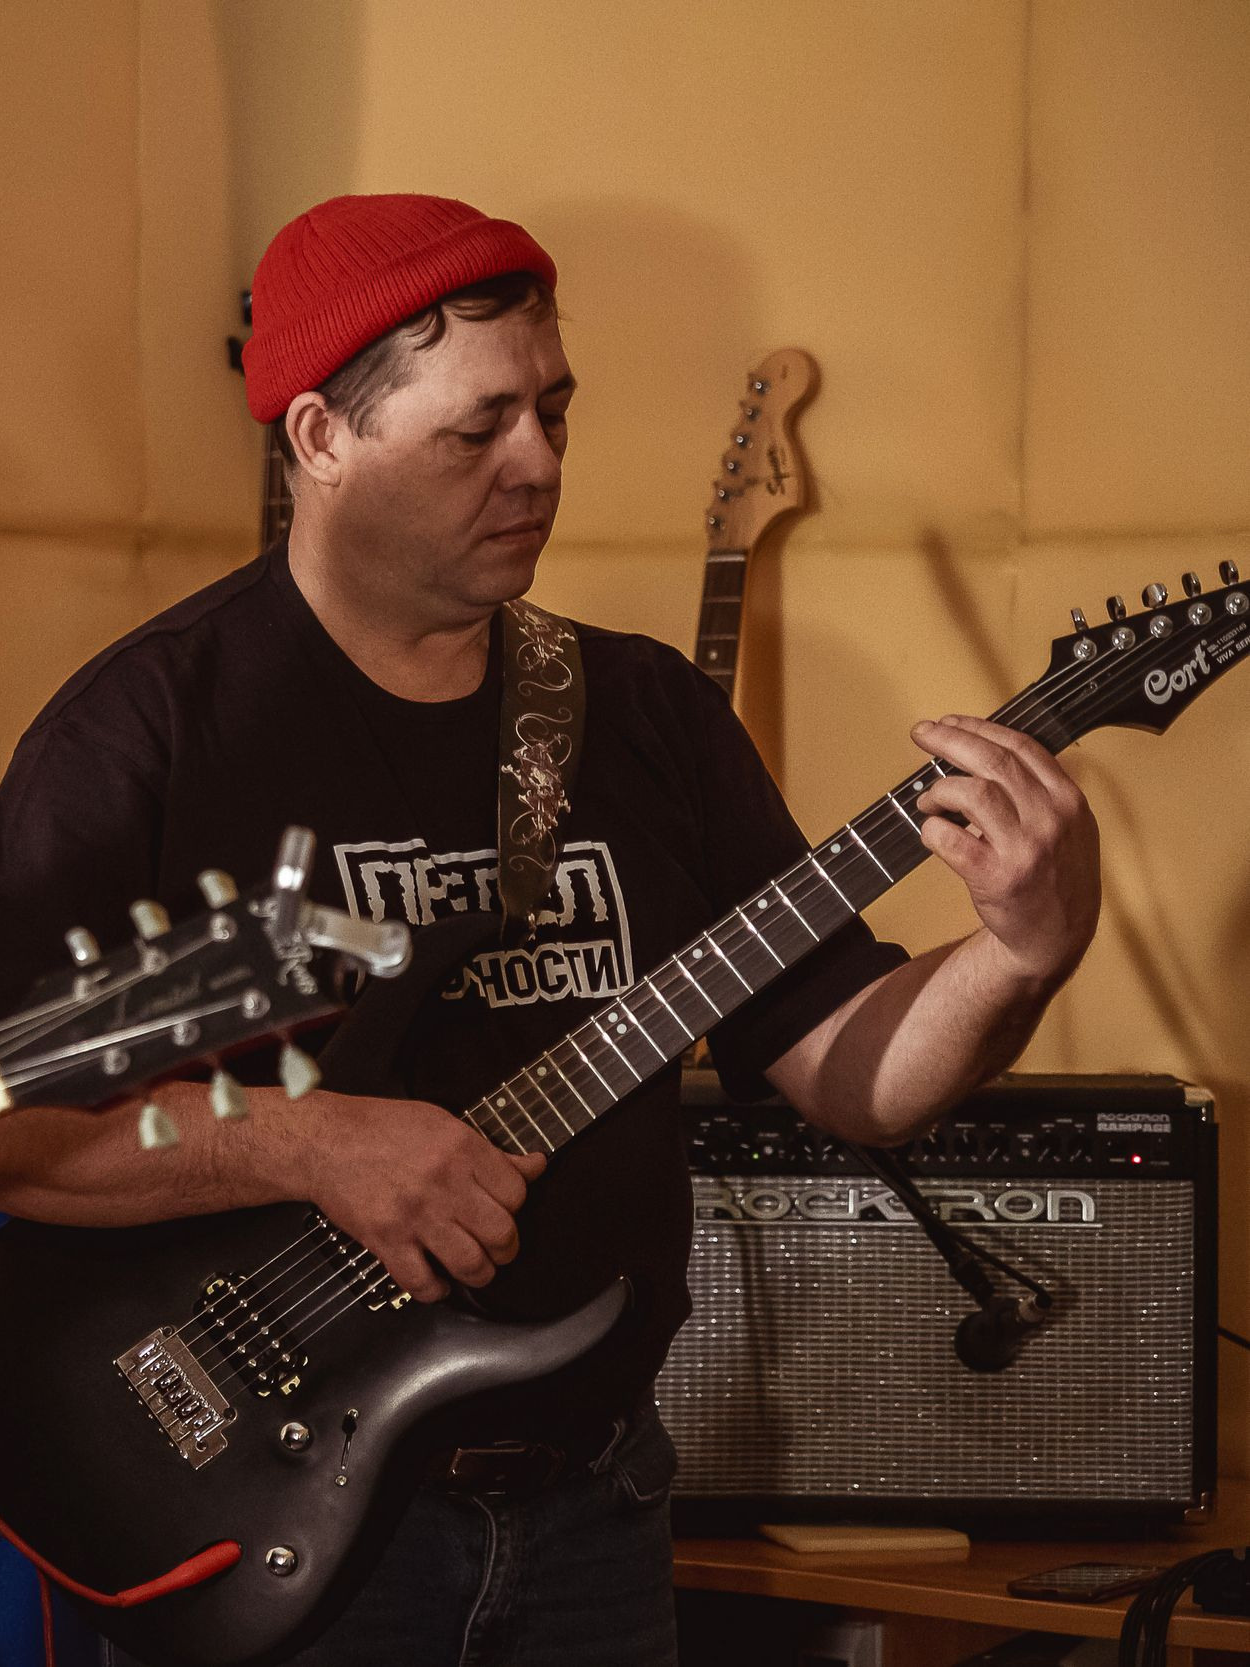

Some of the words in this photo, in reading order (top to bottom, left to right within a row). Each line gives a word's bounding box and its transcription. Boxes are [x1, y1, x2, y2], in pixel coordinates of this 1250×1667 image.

[1144, 643, 1210, 705] Cort
[1096, 1122, 1171, 1133] RAMPAGE
[694, 1187, 1096, 1222] ROCKRON
